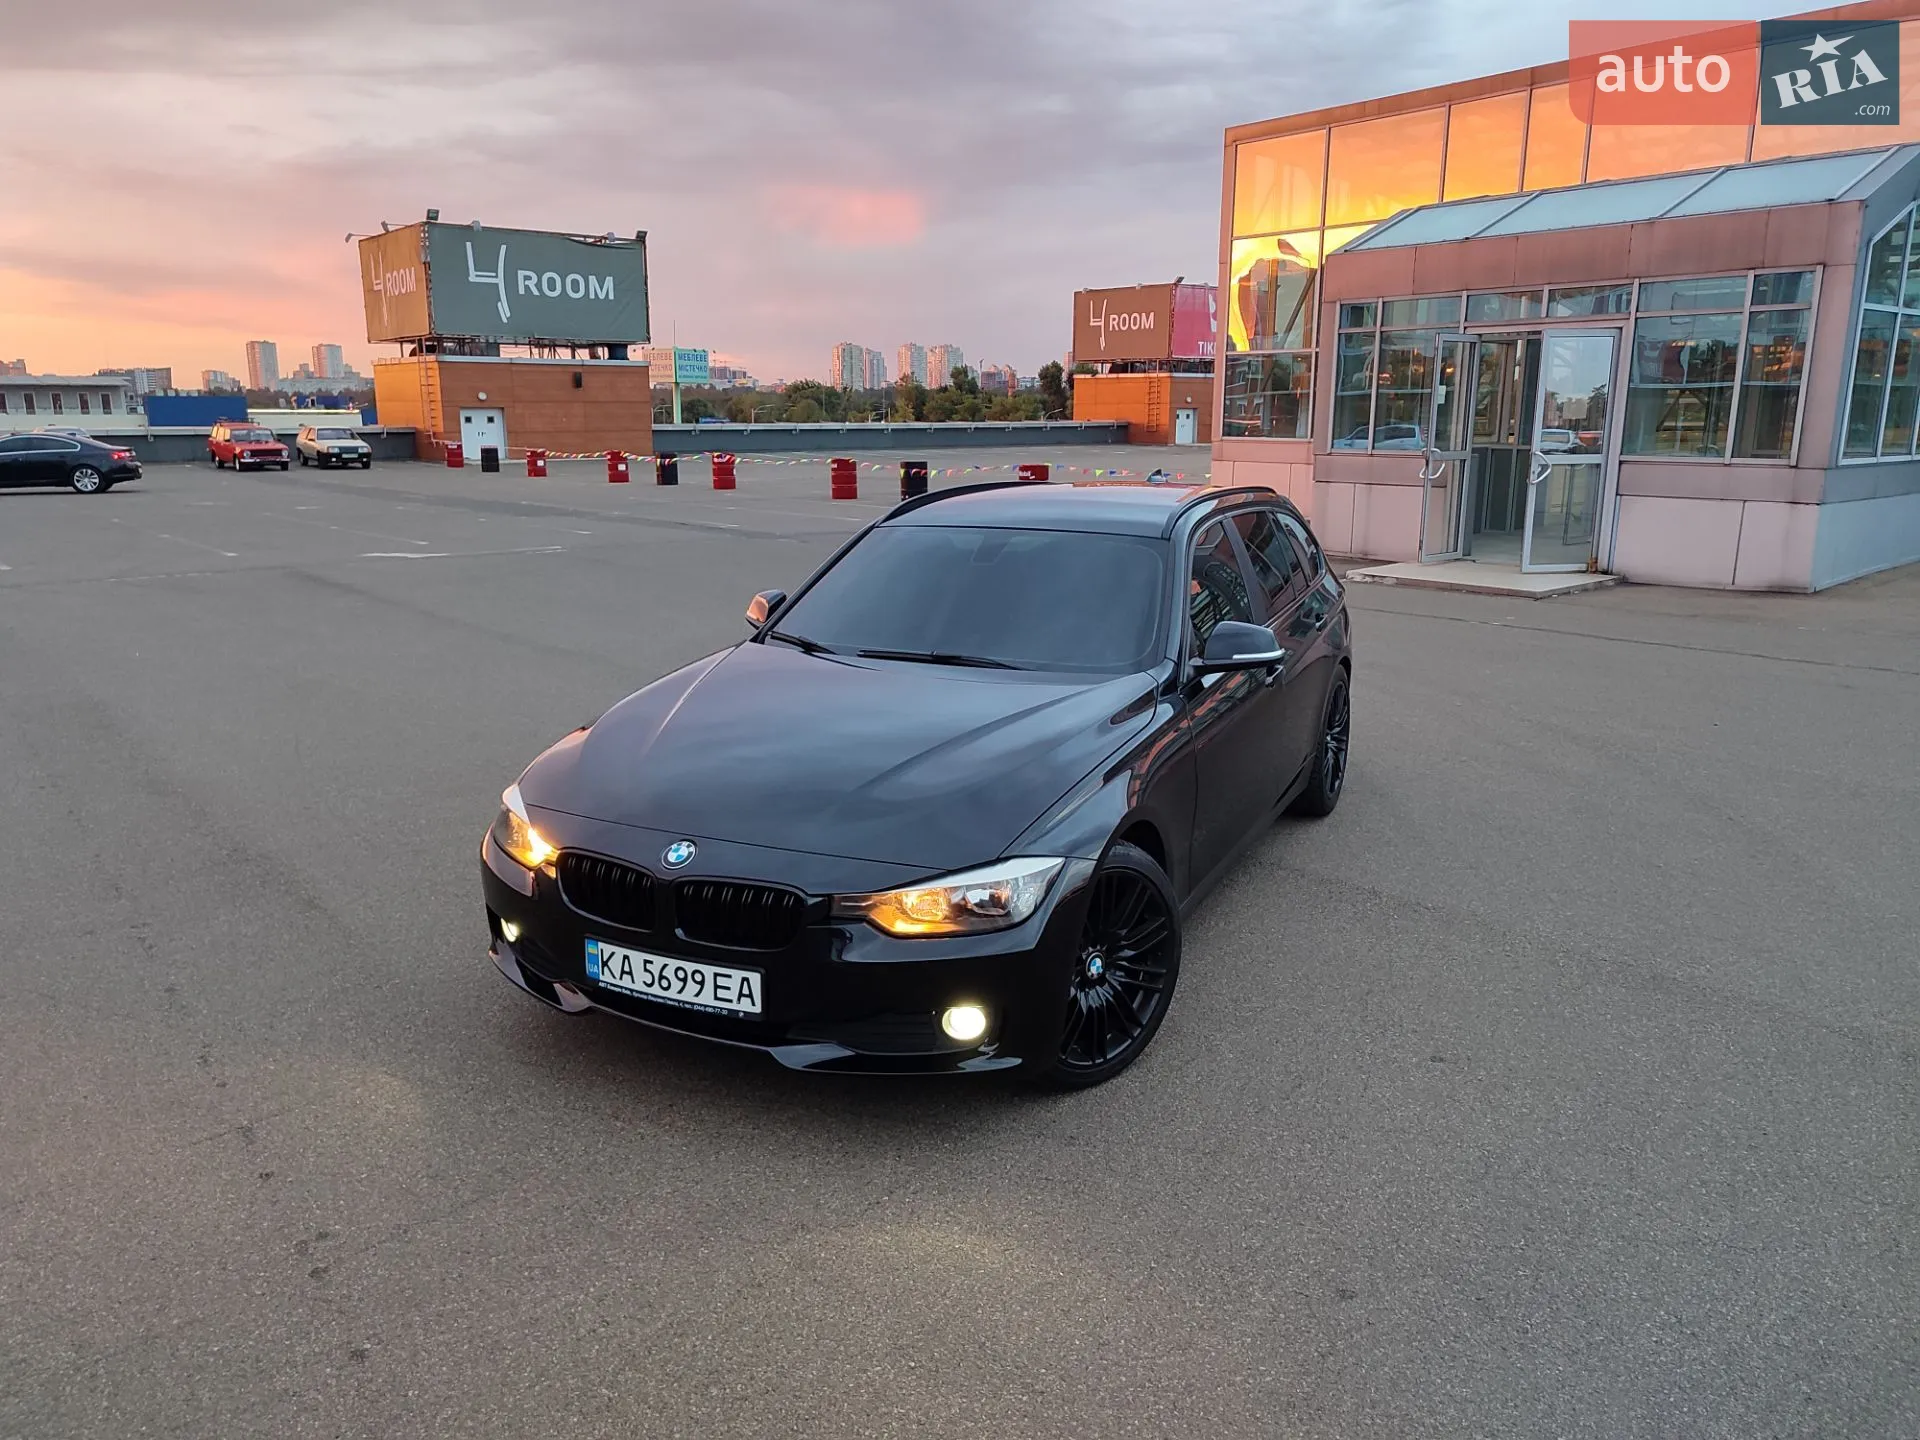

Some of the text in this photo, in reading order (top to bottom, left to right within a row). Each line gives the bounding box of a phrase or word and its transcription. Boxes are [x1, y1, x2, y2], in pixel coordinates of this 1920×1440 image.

[385, 265, 417, 297] ROOM
[517, 269, 615, 300] ROOM
[1109, 311, 1155, 332] ROOM
[588, 964, 599, 974] UA
[642, 959, 706, 998] 5699
